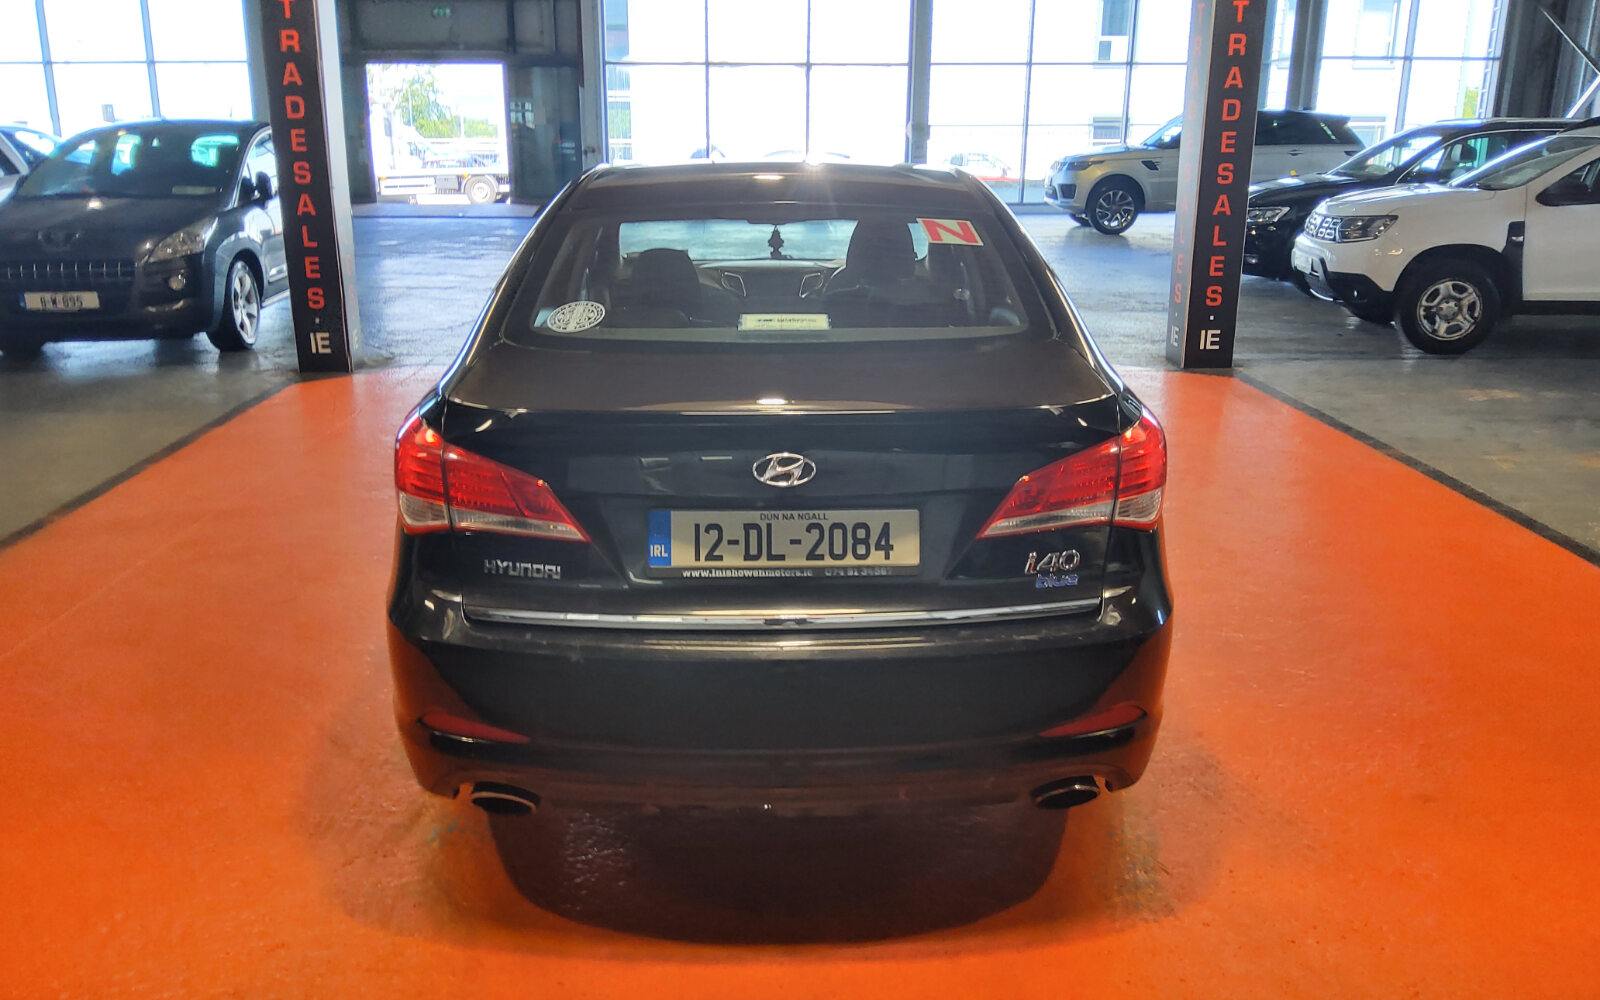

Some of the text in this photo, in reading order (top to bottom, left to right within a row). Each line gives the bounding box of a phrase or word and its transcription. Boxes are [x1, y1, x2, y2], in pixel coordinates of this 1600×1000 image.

[921, 220, 979, 244] N
[782, 512, 795, 521] NA
[797, 512, 829, 521] NGALL
[650, 544, 669, 558] IRL
[694, 522, 894, 562] 12-DL-2084
[484, 559, 561, 580] HYUNDAI
[1024, 549, 1081, 575] i40
